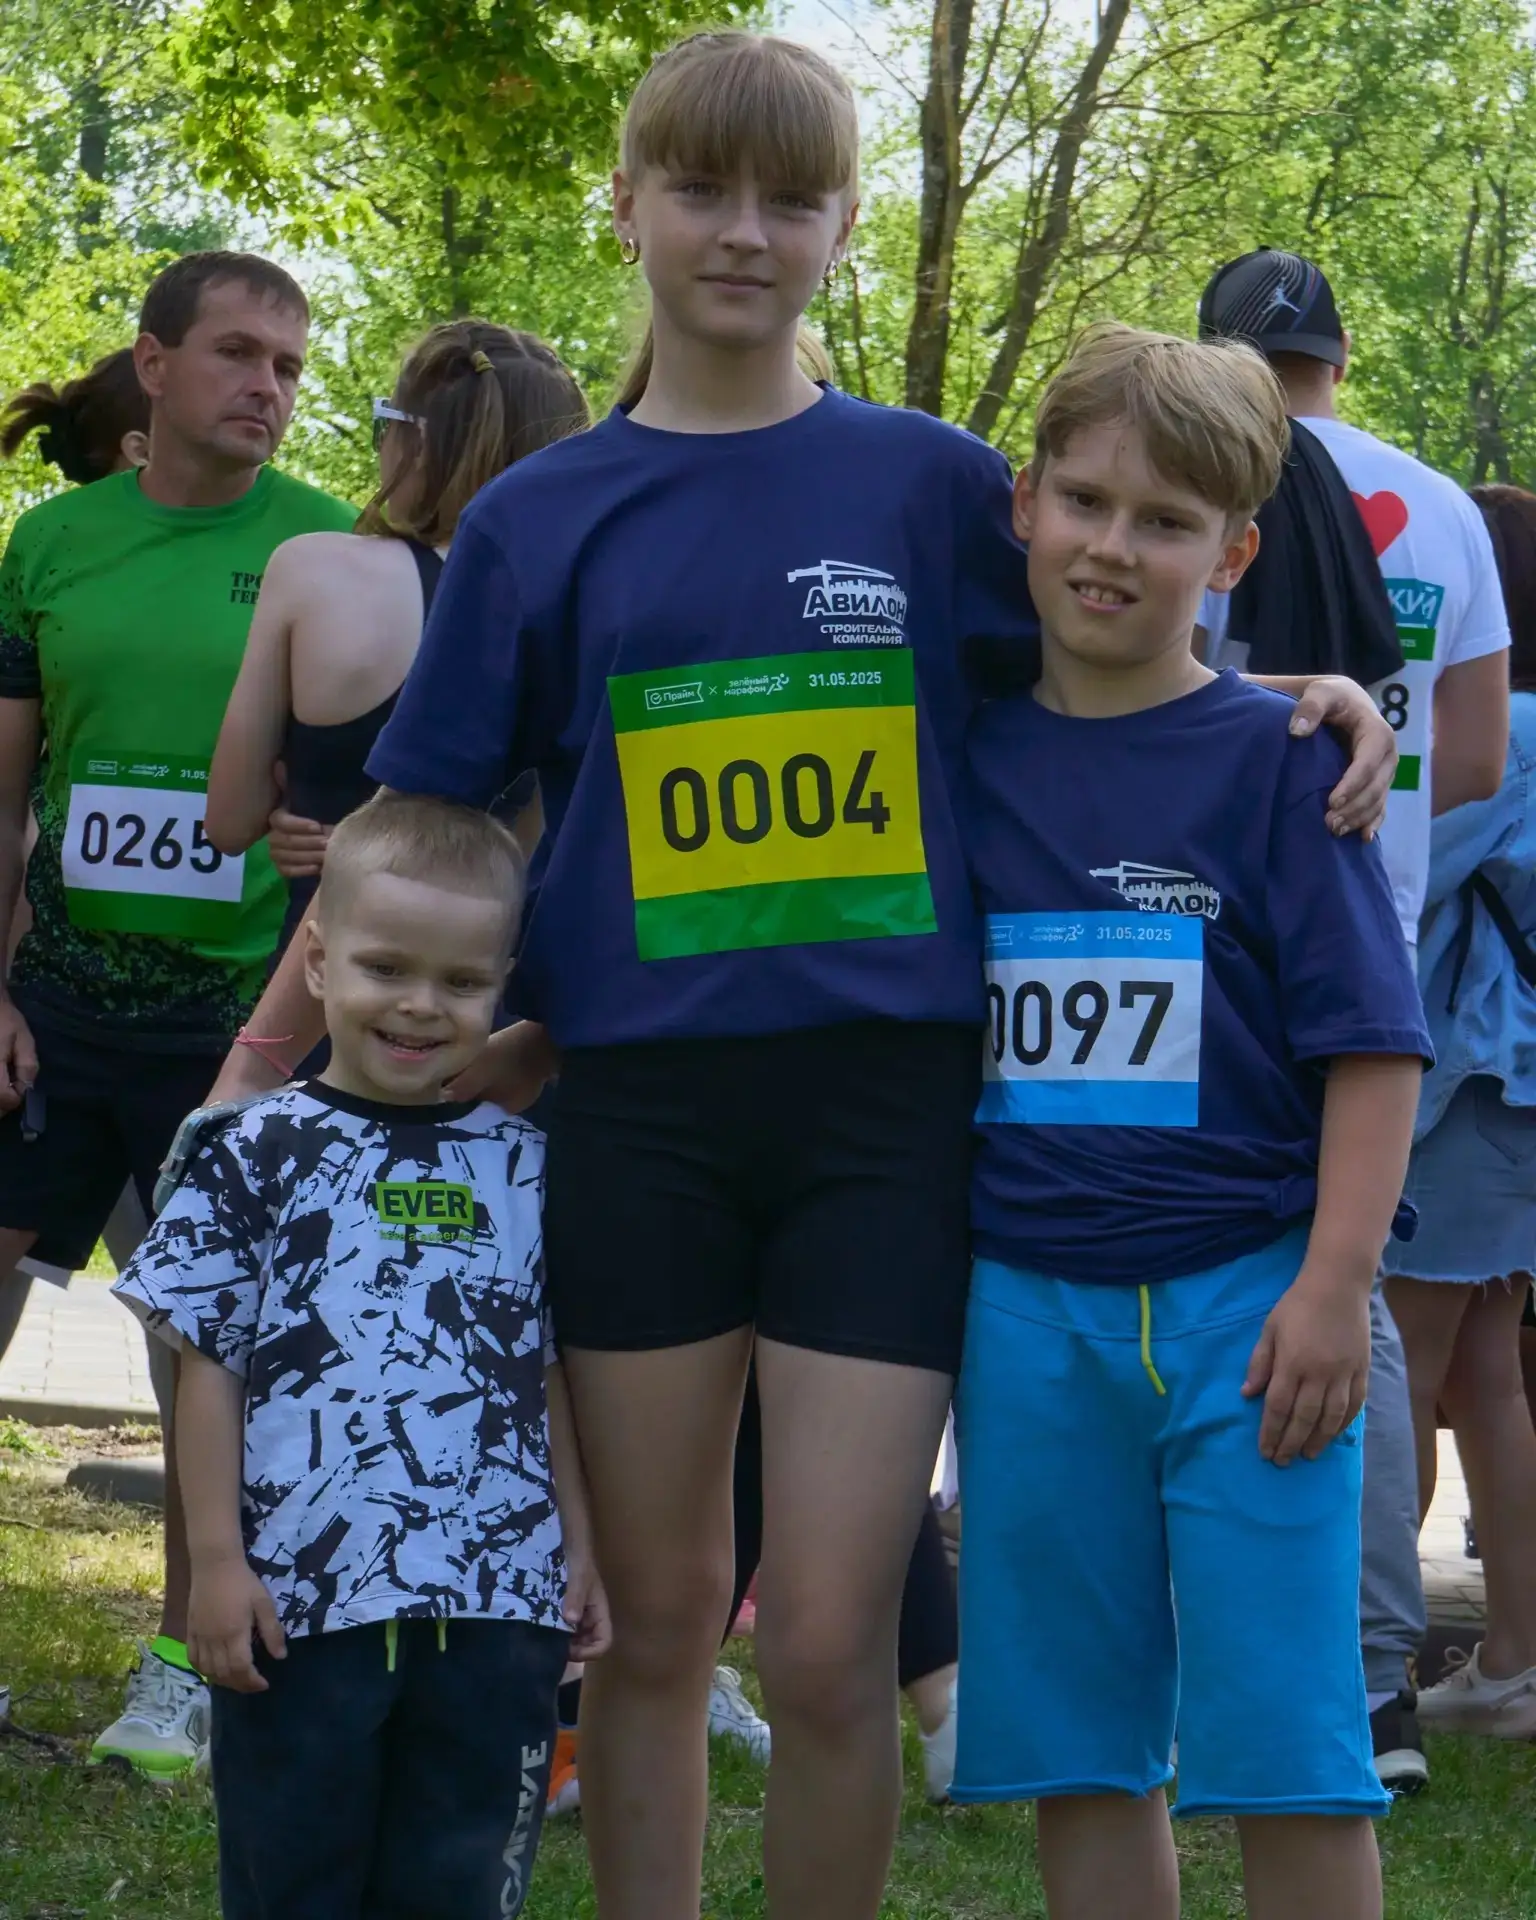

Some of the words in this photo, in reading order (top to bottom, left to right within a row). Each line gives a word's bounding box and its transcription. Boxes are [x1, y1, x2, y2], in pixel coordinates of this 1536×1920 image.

[803, 586, 907, 625] АВИЛОН
[832, 634, 903, 645] КОМПАНИЯ
[728, 674, 769, 688] зелёный
[808, 671, 882, 687] 31.05.2025
[662, 689, 695, 702] Прайм
[724, 685, 766, 697] марафон
[180, 769, 210, 780] 31.05.
[659, 750, 891, 853] 0004
[80, 811, 223, 874] 0265
[1125, 893, 1219, 919] ИЛОН
[1097, 926, 1172, 942] 31.05.2025
[382, 1189, 468, 1218] EVER
